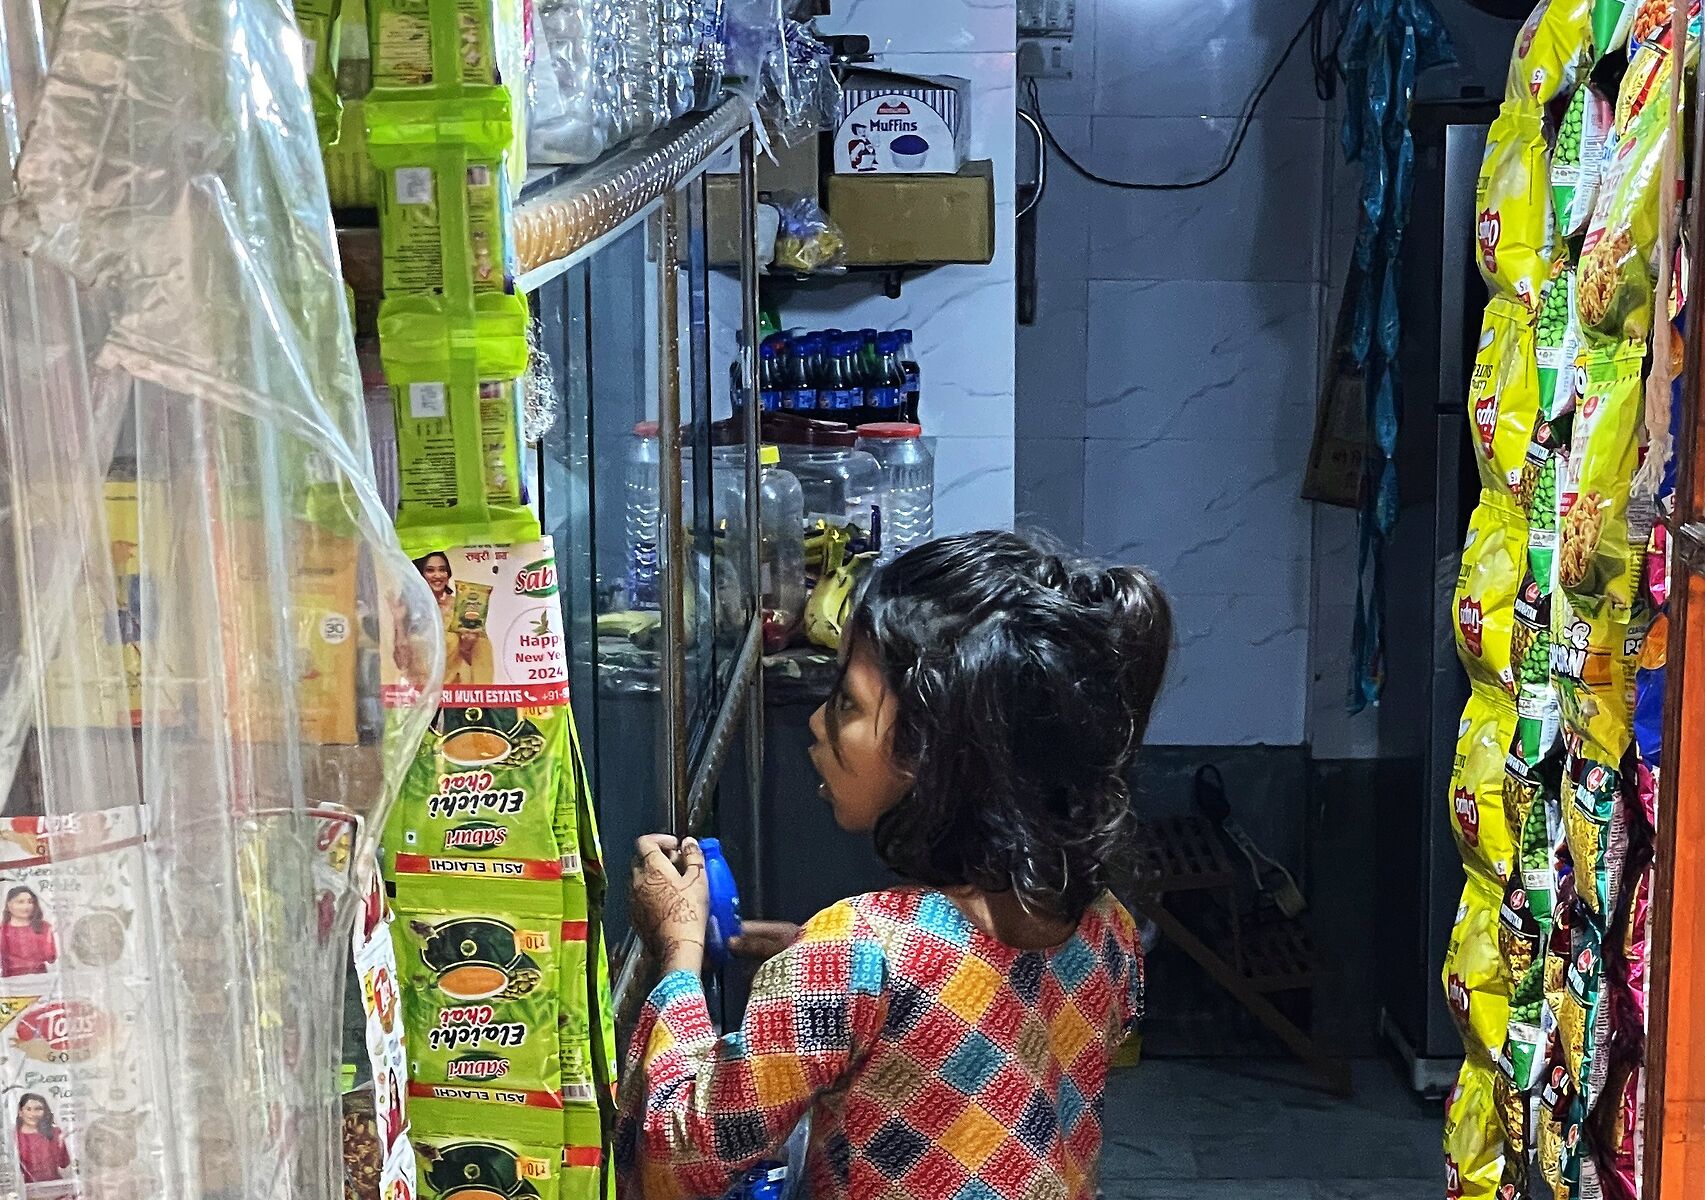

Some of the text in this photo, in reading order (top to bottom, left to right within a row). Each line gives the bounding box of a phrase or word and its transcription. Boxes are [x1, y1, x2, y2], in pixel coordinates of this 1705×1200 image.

[869, 119, 918, 132] Muffins
[325, 622, 345, 634] 30
[520, 634, 561, 649] Happ
[516, 651, 565, 663] New Ye
[528, 667, 563, 680] 2024
[455, 690, 484, 703] MULTI
[486, 690, 523, 704] ESTATE
[439, 772, 494, 791] Chai
[429, 790, 525, 817] Elaichi
[431, 858, 524, 874] ASLI ELAICHI
[440, 1007, 493, 1027] Chai
[429, 1024, 525, 1049] Elaichi
[433, 1088, 526, 1103] ASLI ELAICHI
